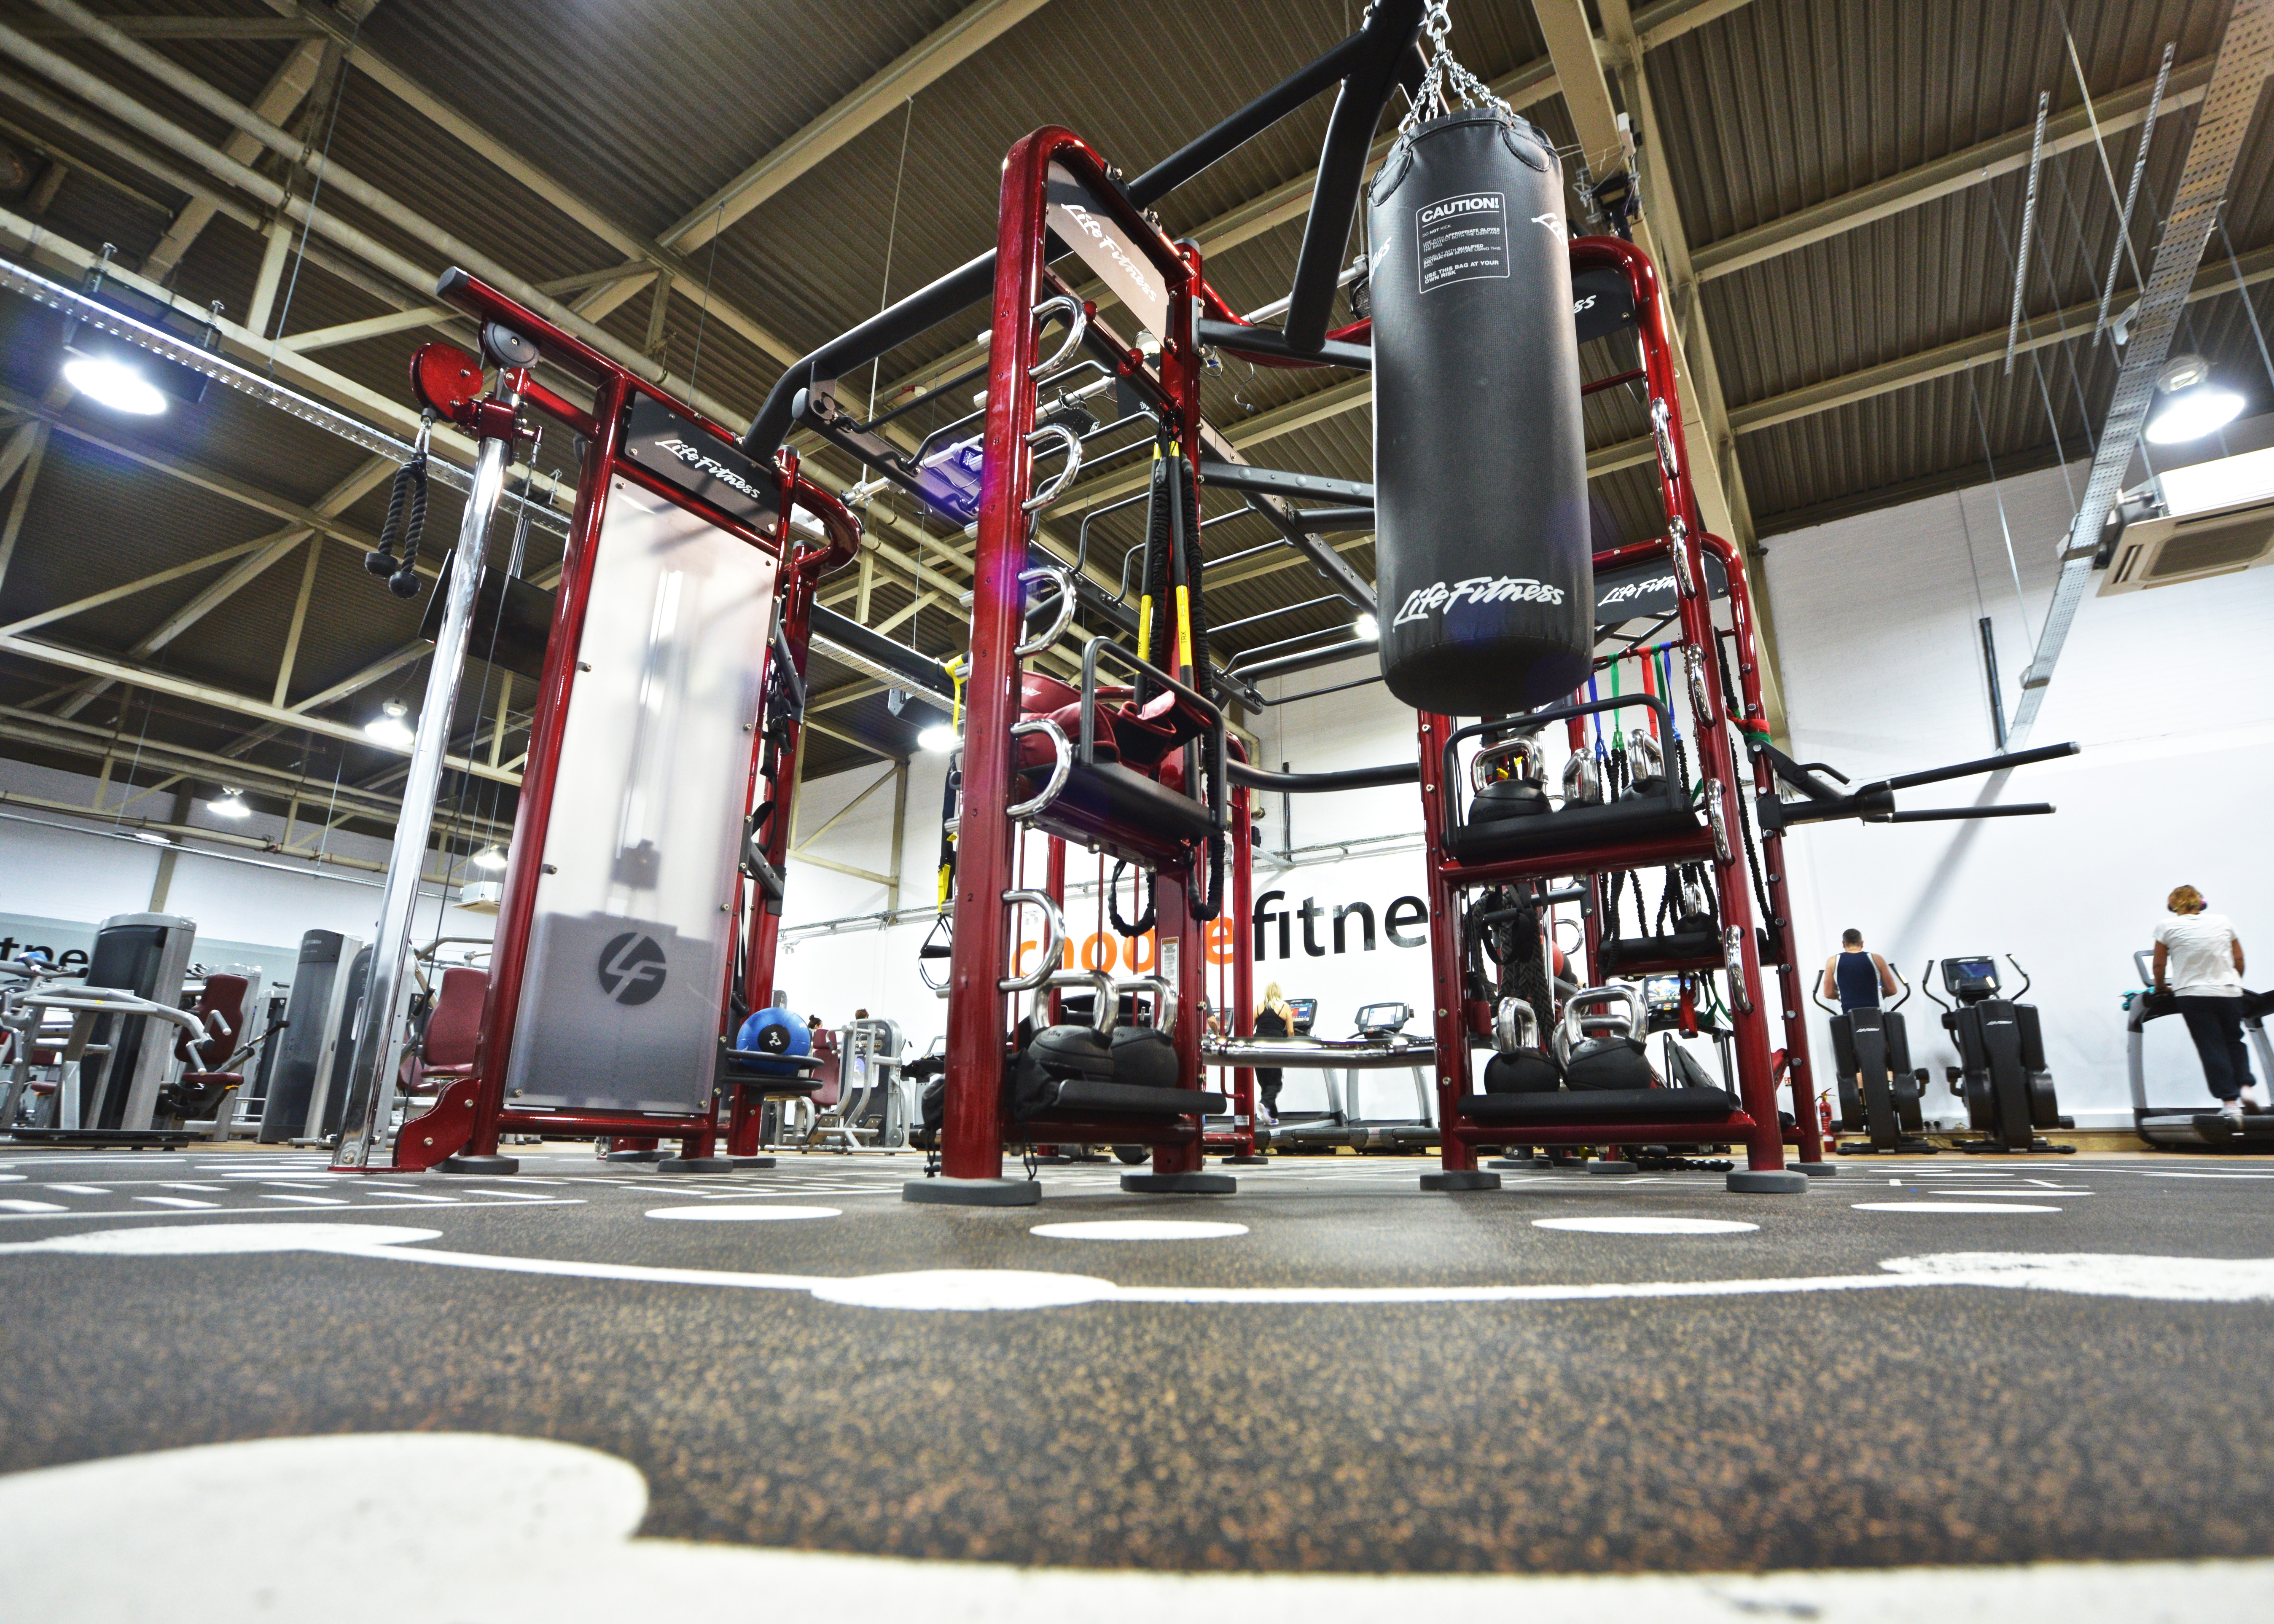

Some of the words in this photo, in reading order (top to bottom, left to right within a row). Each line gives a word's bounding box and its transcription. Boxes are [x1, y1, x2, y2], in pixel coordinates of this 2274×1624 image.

[1422, 198, 1499, 222] CAUTION!
[1445, 228, 1478, 237] APPROPRIATE
[1430, 236, 1450, 247] PROTECT
[1061, 203, 1102, 237] Life
[1099, 235, 1156, 302] Fitness
[1423, 252, 1443, 262] CONSULT
[1424, 252, 1453, 265] INSTRUCTOR
[1425, 271, 1436, 279] USE
[655, 439, 699, 460] Life
[695, 456, 760, 498] Fitness
[1598, 584, 1637, 607] Life
[1635, 575, 1677, 599] Fitn
[1392, 582, 1449, 633] Life
[1443, 575, 1564, 615] Fitness
[982, 649, 987, 658] 5
[973, 808, 978, 817] 3
[968, 893, 973, 902] 2
[1252, 890, 1429, 962] fitne
